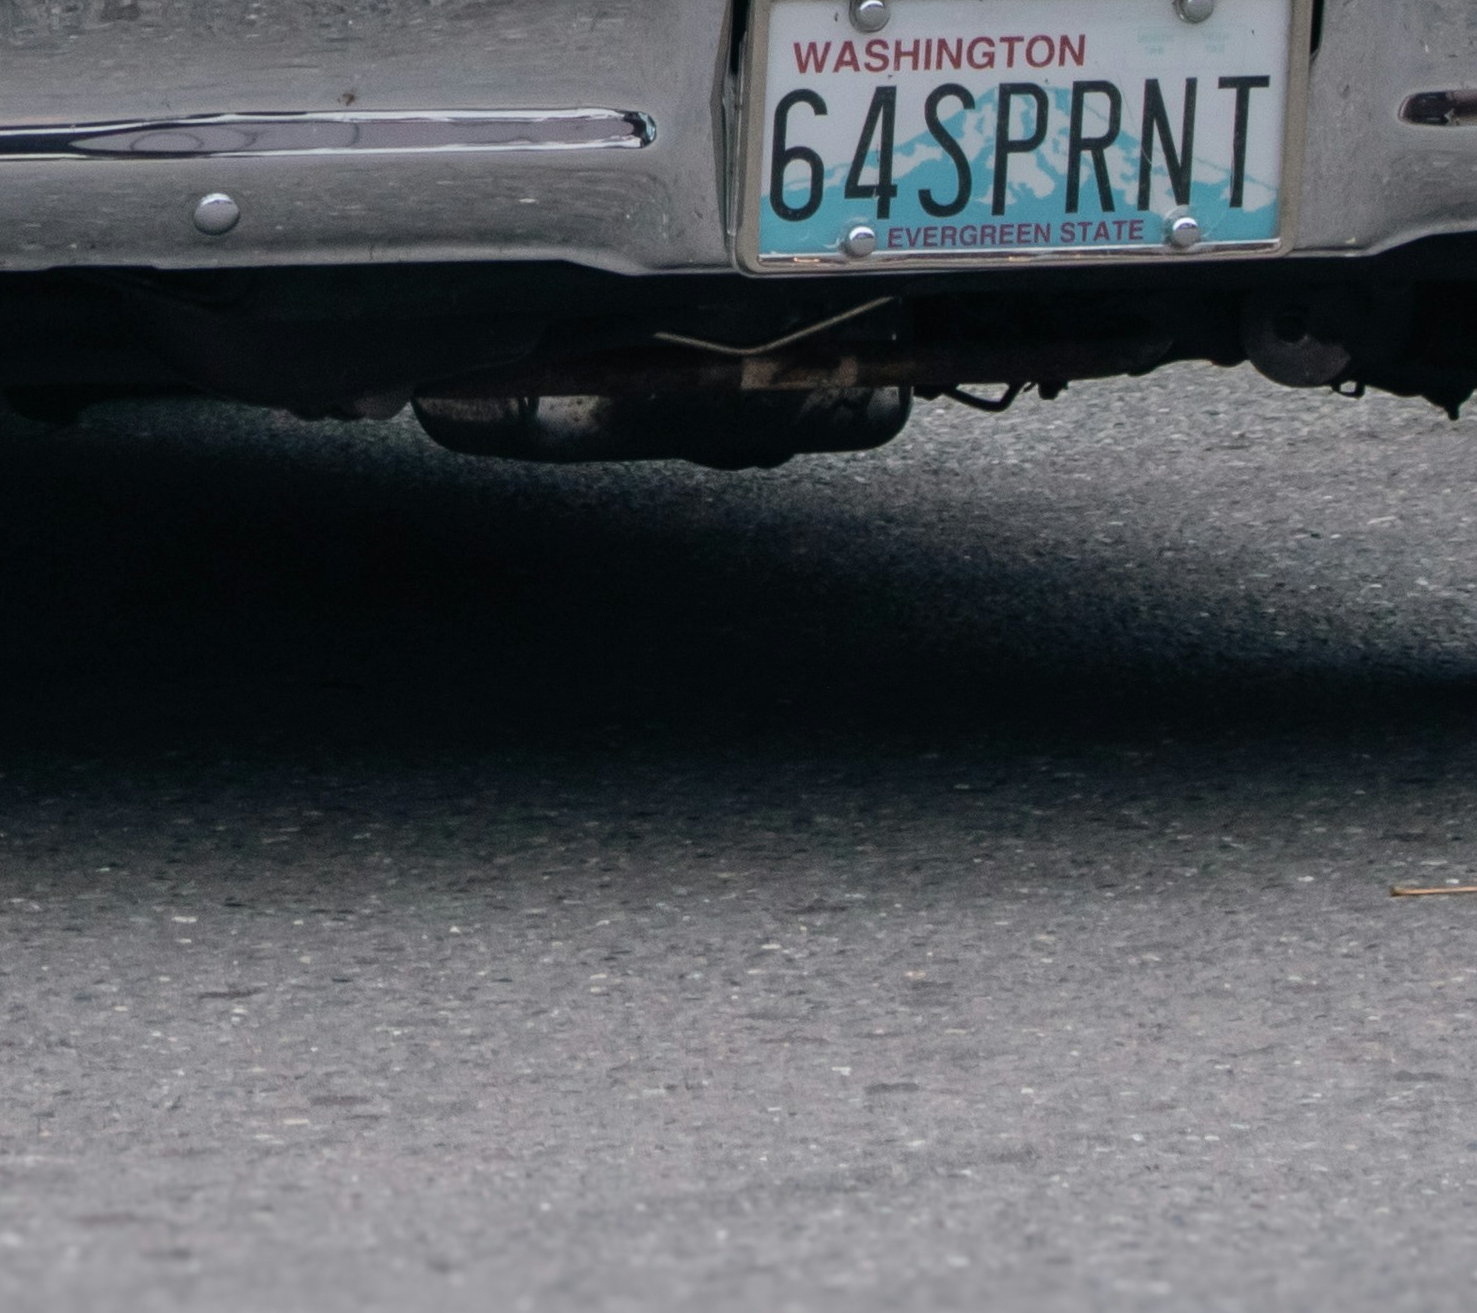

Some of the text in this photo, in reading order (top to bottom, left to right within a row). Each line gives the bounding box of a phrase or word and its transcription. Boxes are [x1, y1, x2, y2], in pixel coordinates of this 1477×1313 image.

[794, 34, 1086, 74] WASHINGTON
[769, 75, 1270, 222] 64SPRNT
[887, 219, 1144, 248] EVERGREEN STATE
